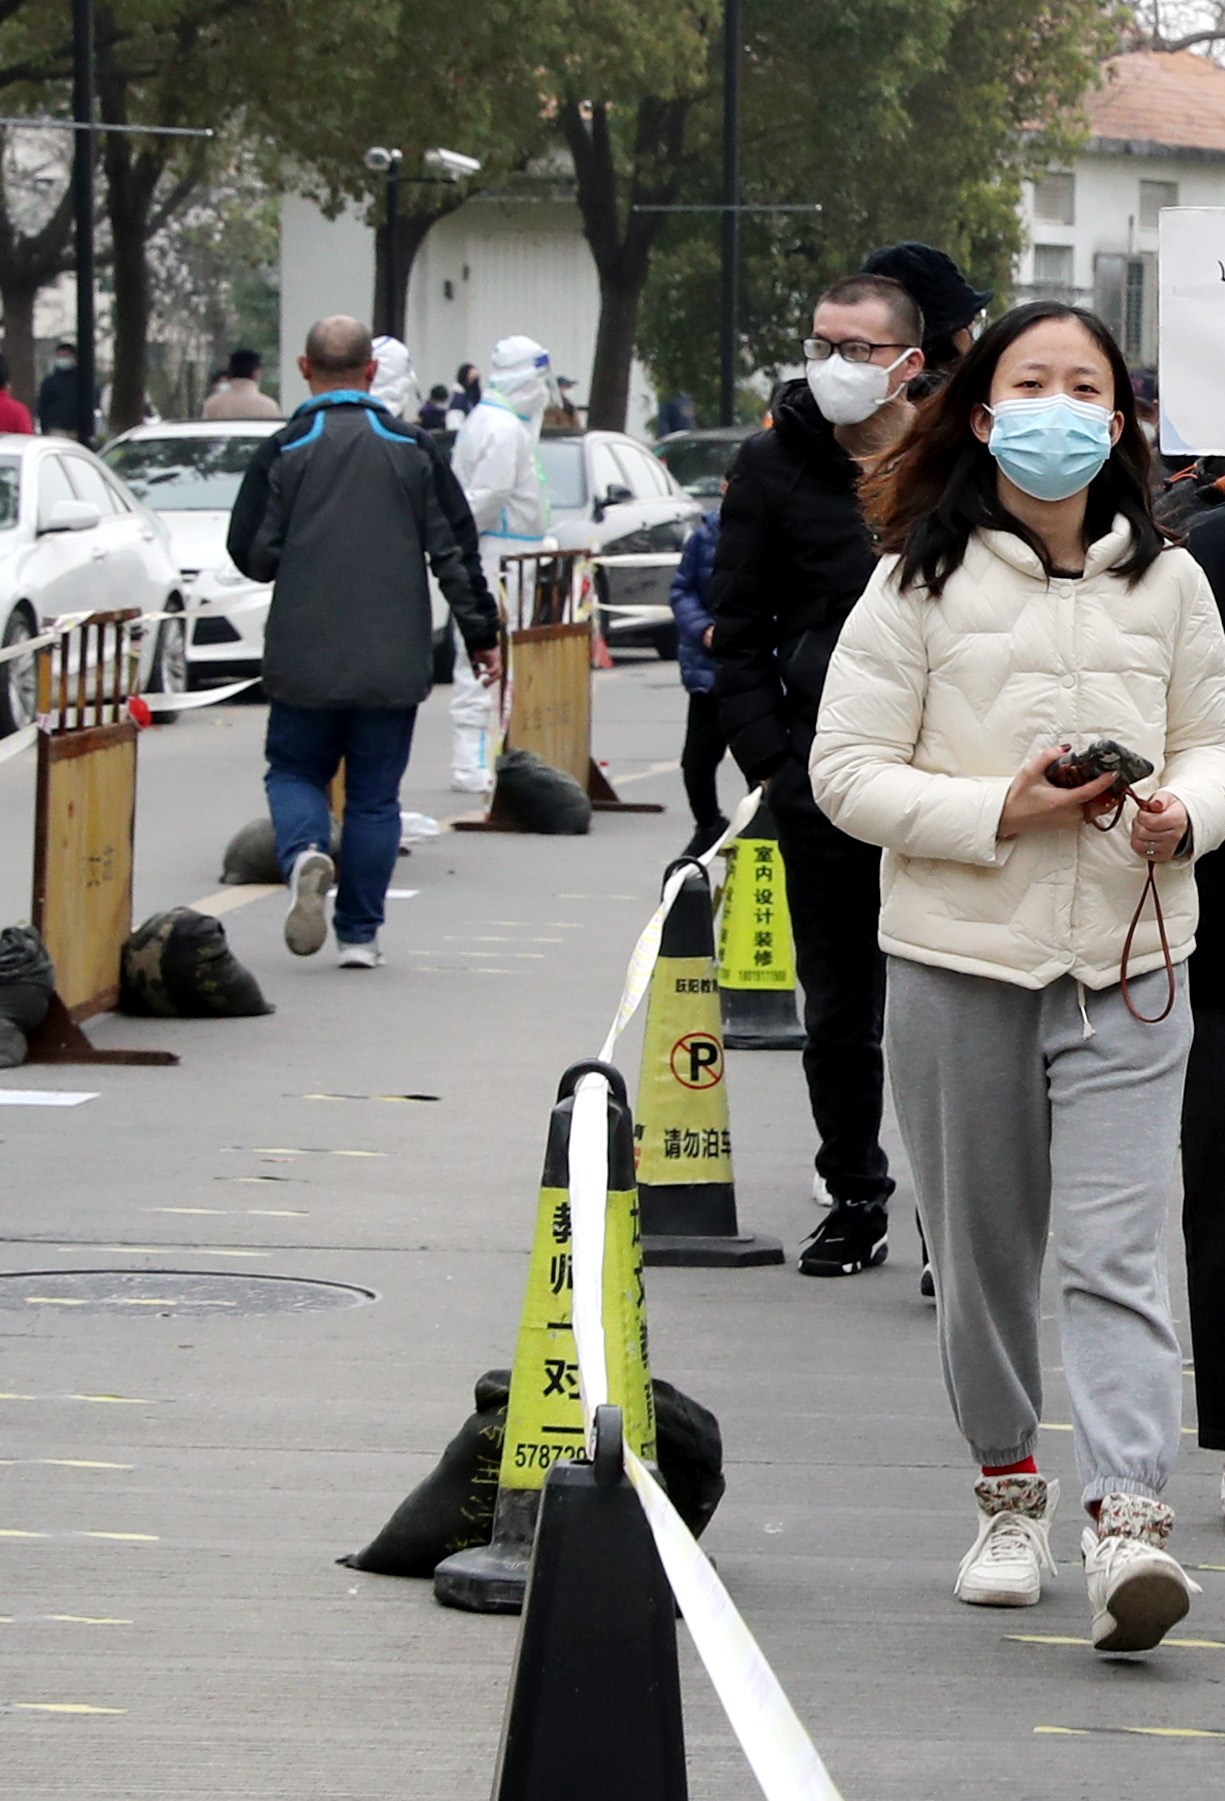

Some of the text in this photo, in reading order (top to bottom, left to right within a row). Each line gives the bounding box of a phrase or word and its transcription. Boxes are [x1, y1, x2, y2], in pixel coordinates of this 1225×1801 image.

[752, 846, 774, 967] 室内设计装修
[663, 1127, 732, 1159] 请勿泊车
